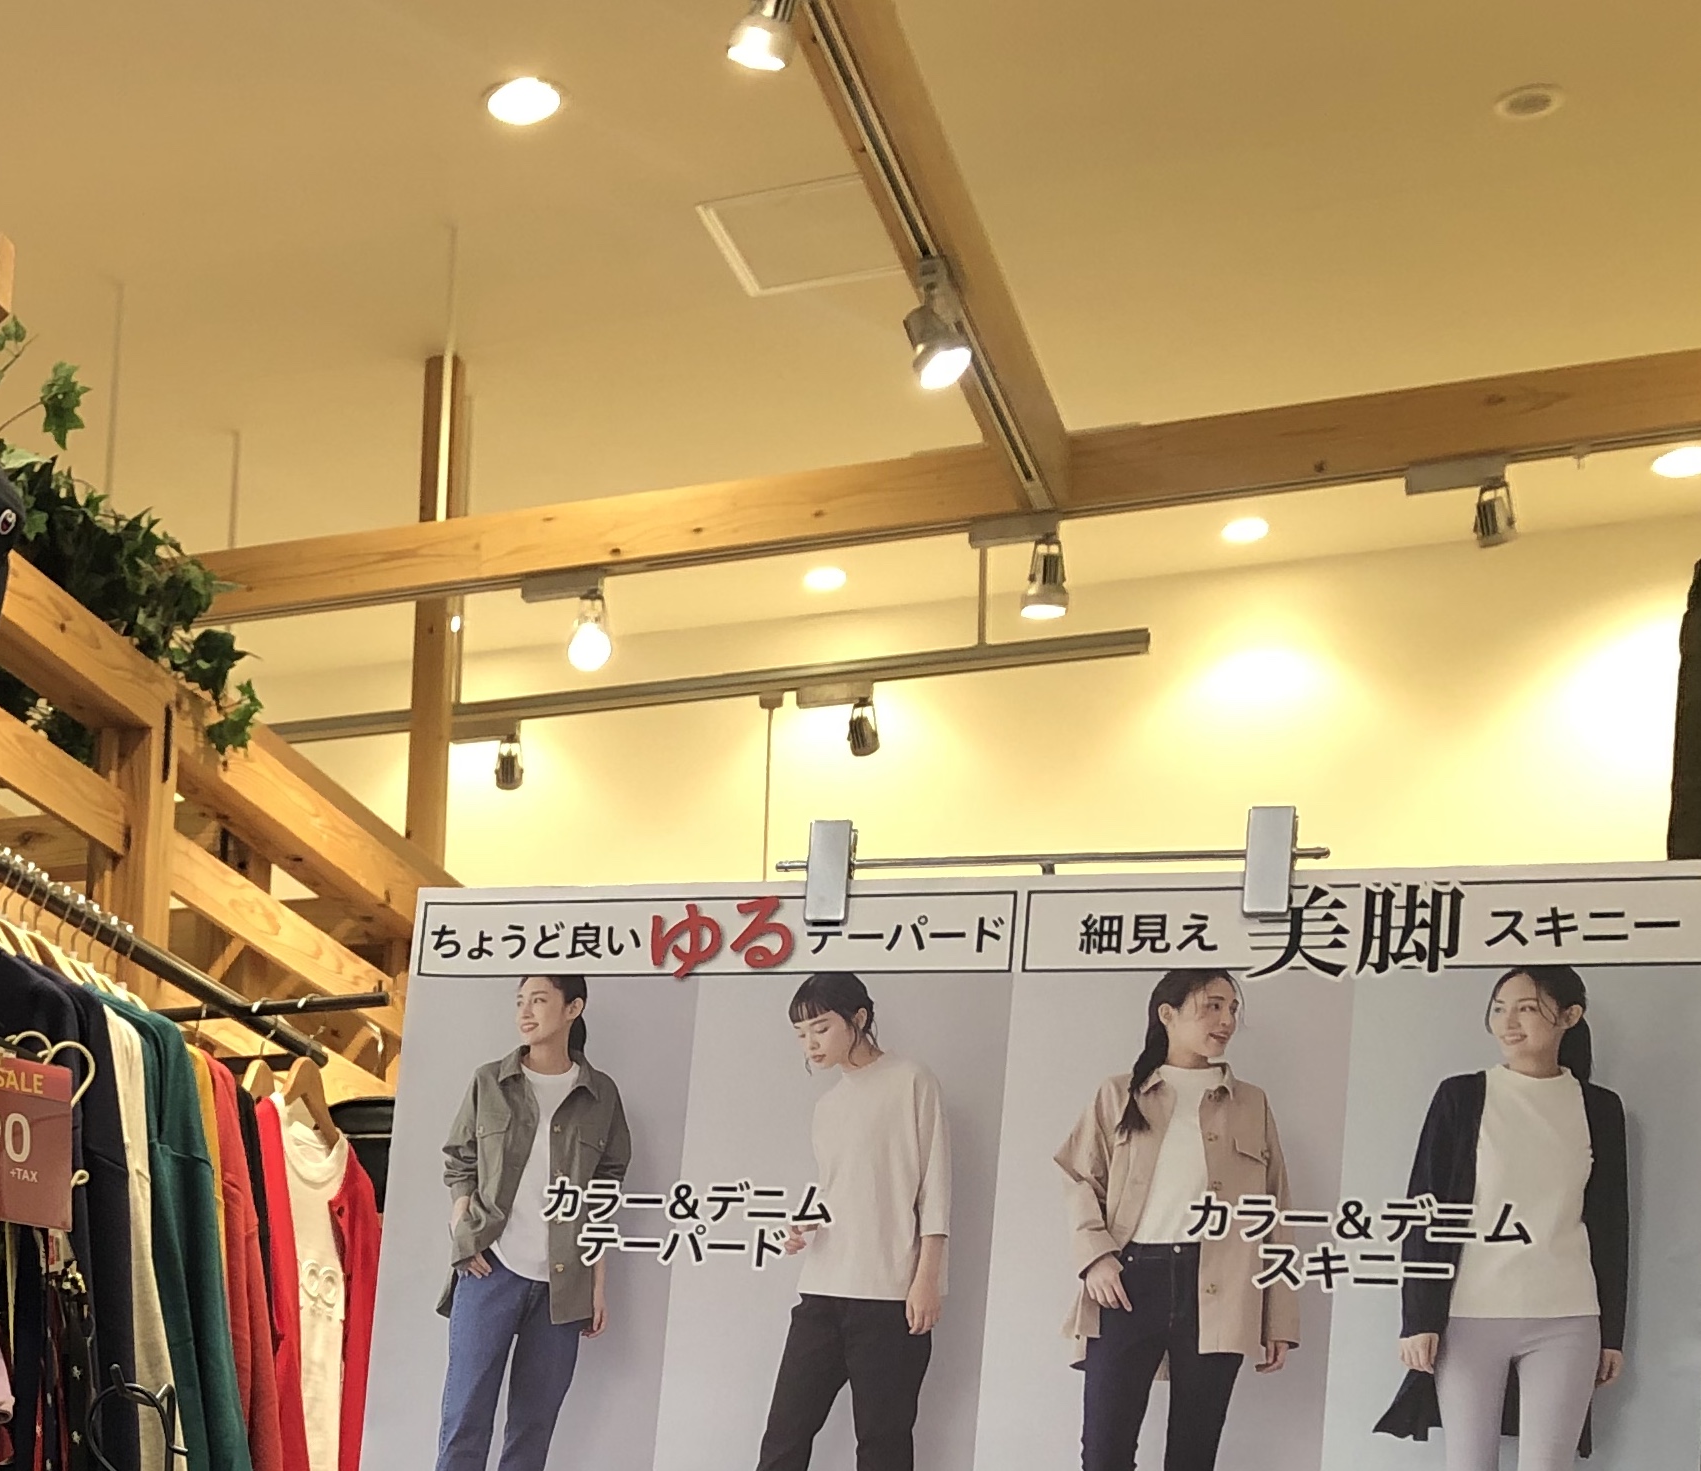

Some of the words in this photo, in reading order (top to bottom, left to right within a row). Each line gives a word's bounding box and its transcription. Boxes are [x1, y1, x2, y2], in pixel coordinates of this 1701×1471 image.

[1484, 906, 1680, 948] スキニー
[10, 1168, 39, 1183] +TAX
[580, 1224, 787, 1268] テーパード
[1256, 1246, 1451, 1290] スキニー
